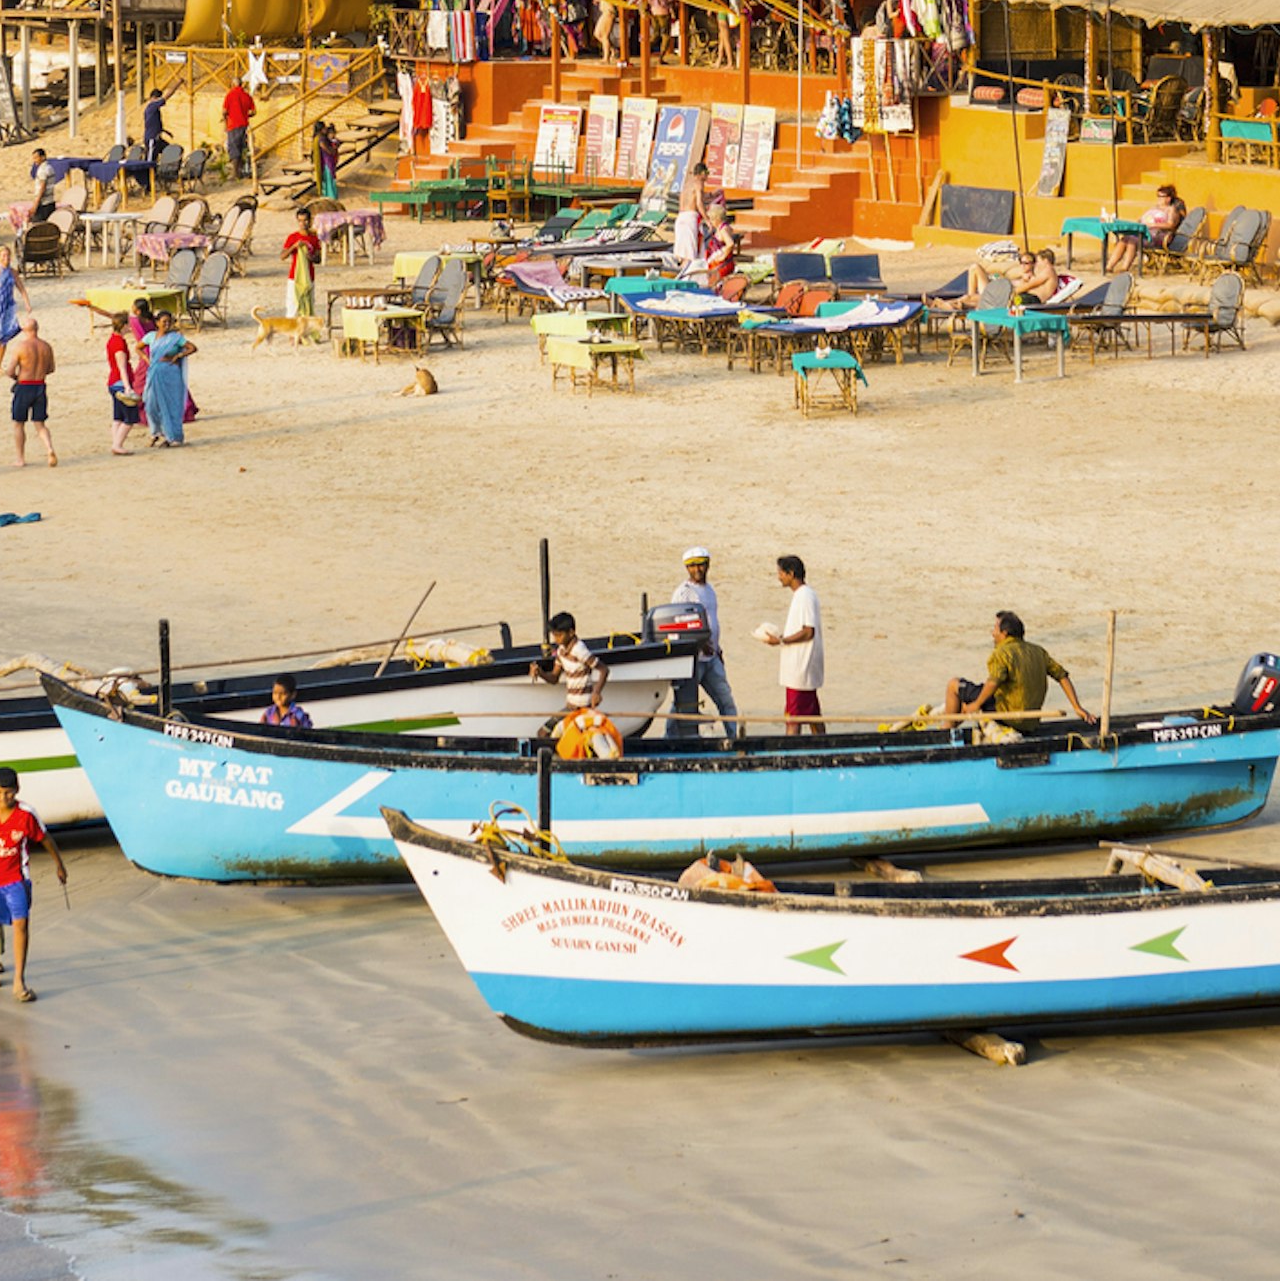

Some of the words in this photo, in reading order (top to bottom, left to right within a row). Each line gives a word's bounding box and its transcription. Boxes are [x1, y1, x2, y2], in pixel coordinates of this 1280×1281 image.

[656, 142, 687, 157] PEPSI
[178, 757, 217, 779] MY
[226, 762, 273, 786] PAT
[165, 779, 285, 811] GAURANG
[501, 905, 539, 932] SHREE
[541, 897, 630, 918] MALLIKARJUN
[631, 908, 687, 948] PRASSAN
[560, 915, 599, 928] RENUKA
[601, 916, 651, 945] PRASANNA
[551, 936, 592, 951] SUVARN
[595, 940, 638, 954] GANESH
